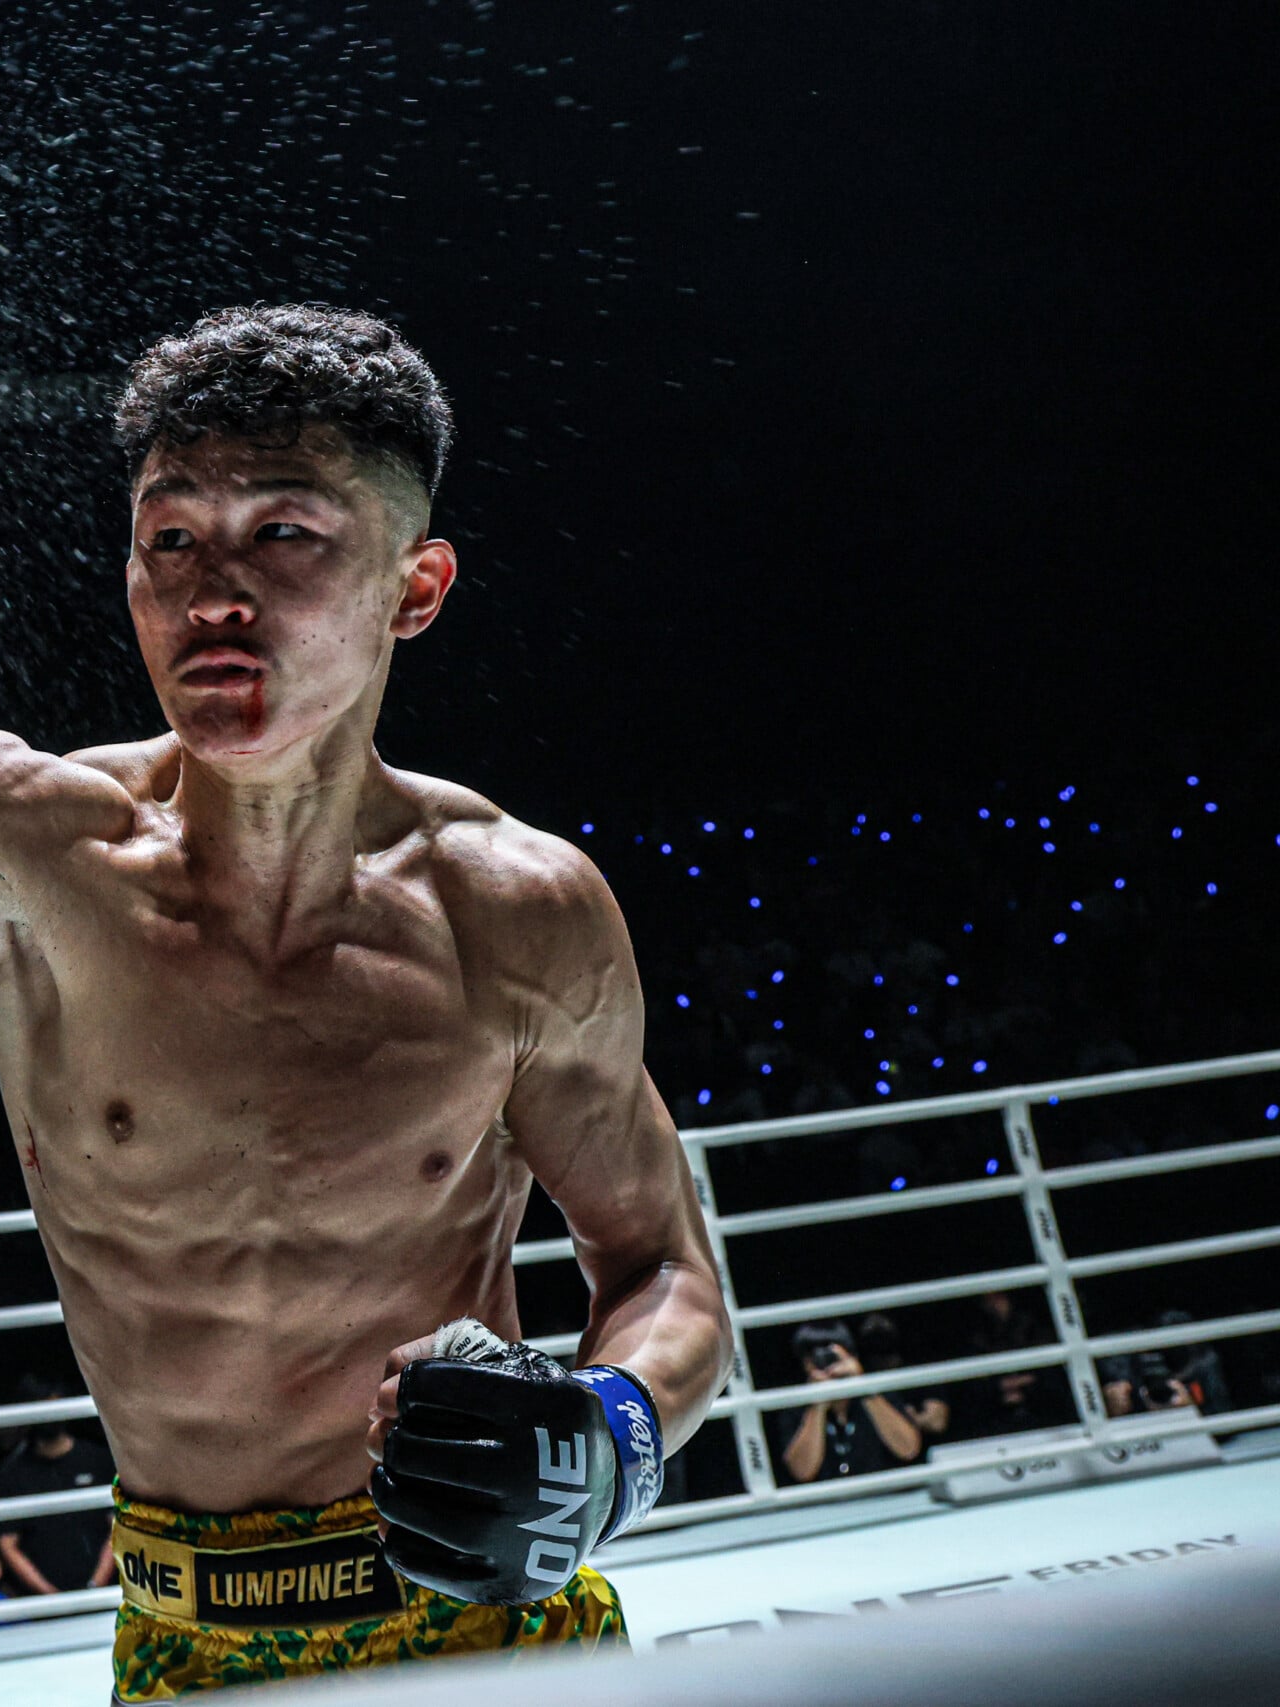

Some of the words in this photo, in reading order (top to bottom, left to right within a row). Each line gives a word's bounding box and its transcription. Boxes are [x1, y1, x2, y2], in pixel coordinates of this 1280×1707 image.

[517, 1426, 592, 1585] ONE
[123, 1547, 183, 1602] ONE
[209, 1553, 376, 1607] LUMPINEE
[1026, 1534, 1239, 1581] FRIDAY
